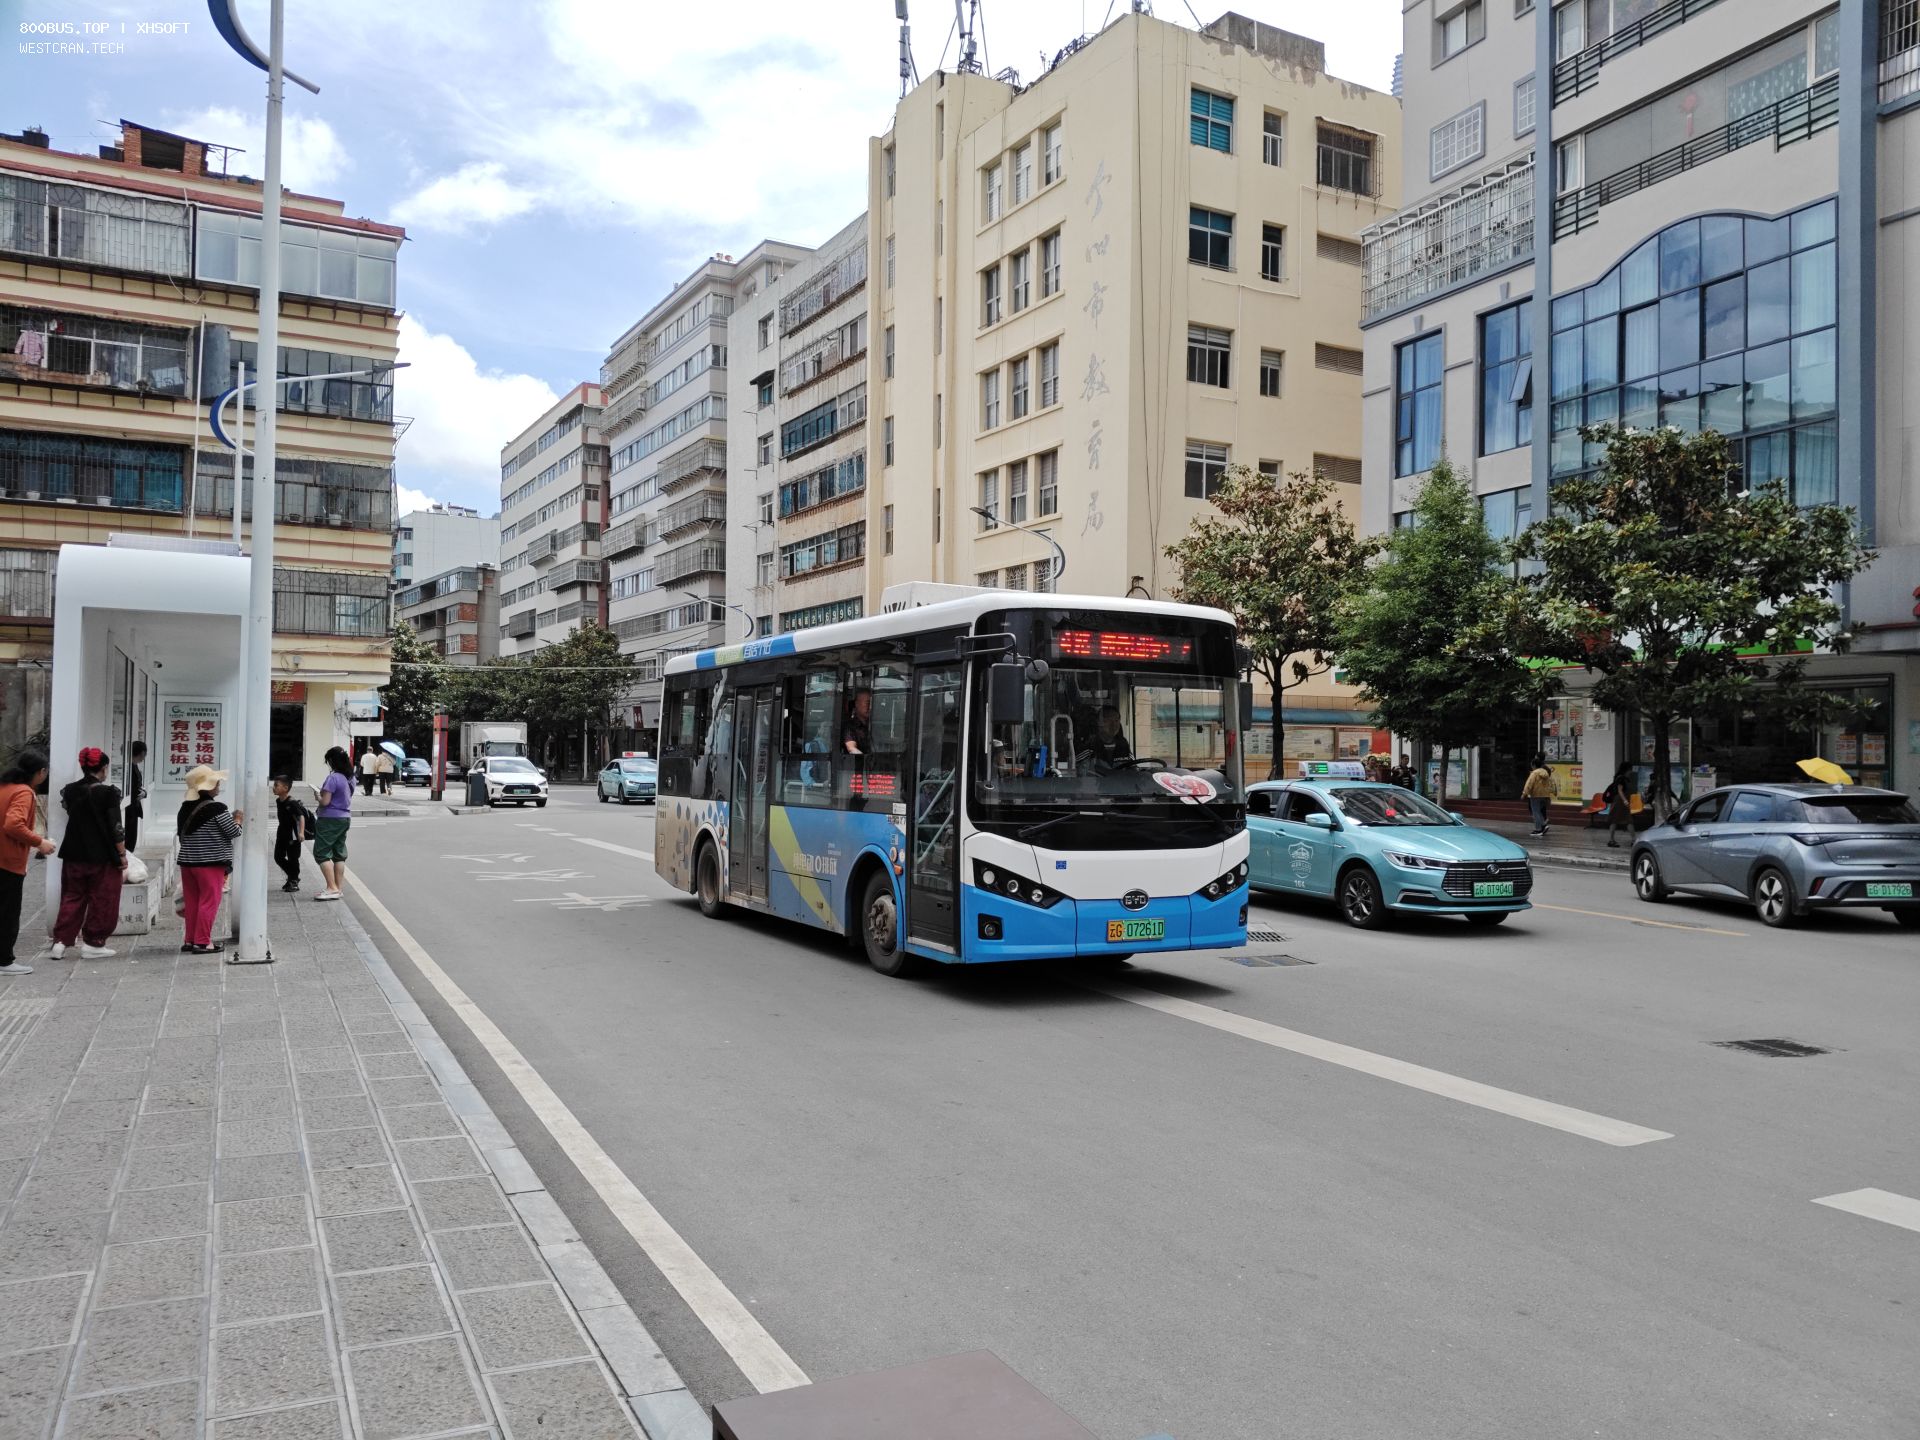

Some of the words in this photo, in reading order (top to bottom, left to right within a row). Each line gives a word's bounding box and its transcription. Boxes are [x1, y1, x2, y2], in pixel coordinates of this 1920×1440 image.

[170, 719, 190, 764] 有充电桩
[195, 719, 215, 764] 停车场设
[1124, 895, 1147, 905] BYD
